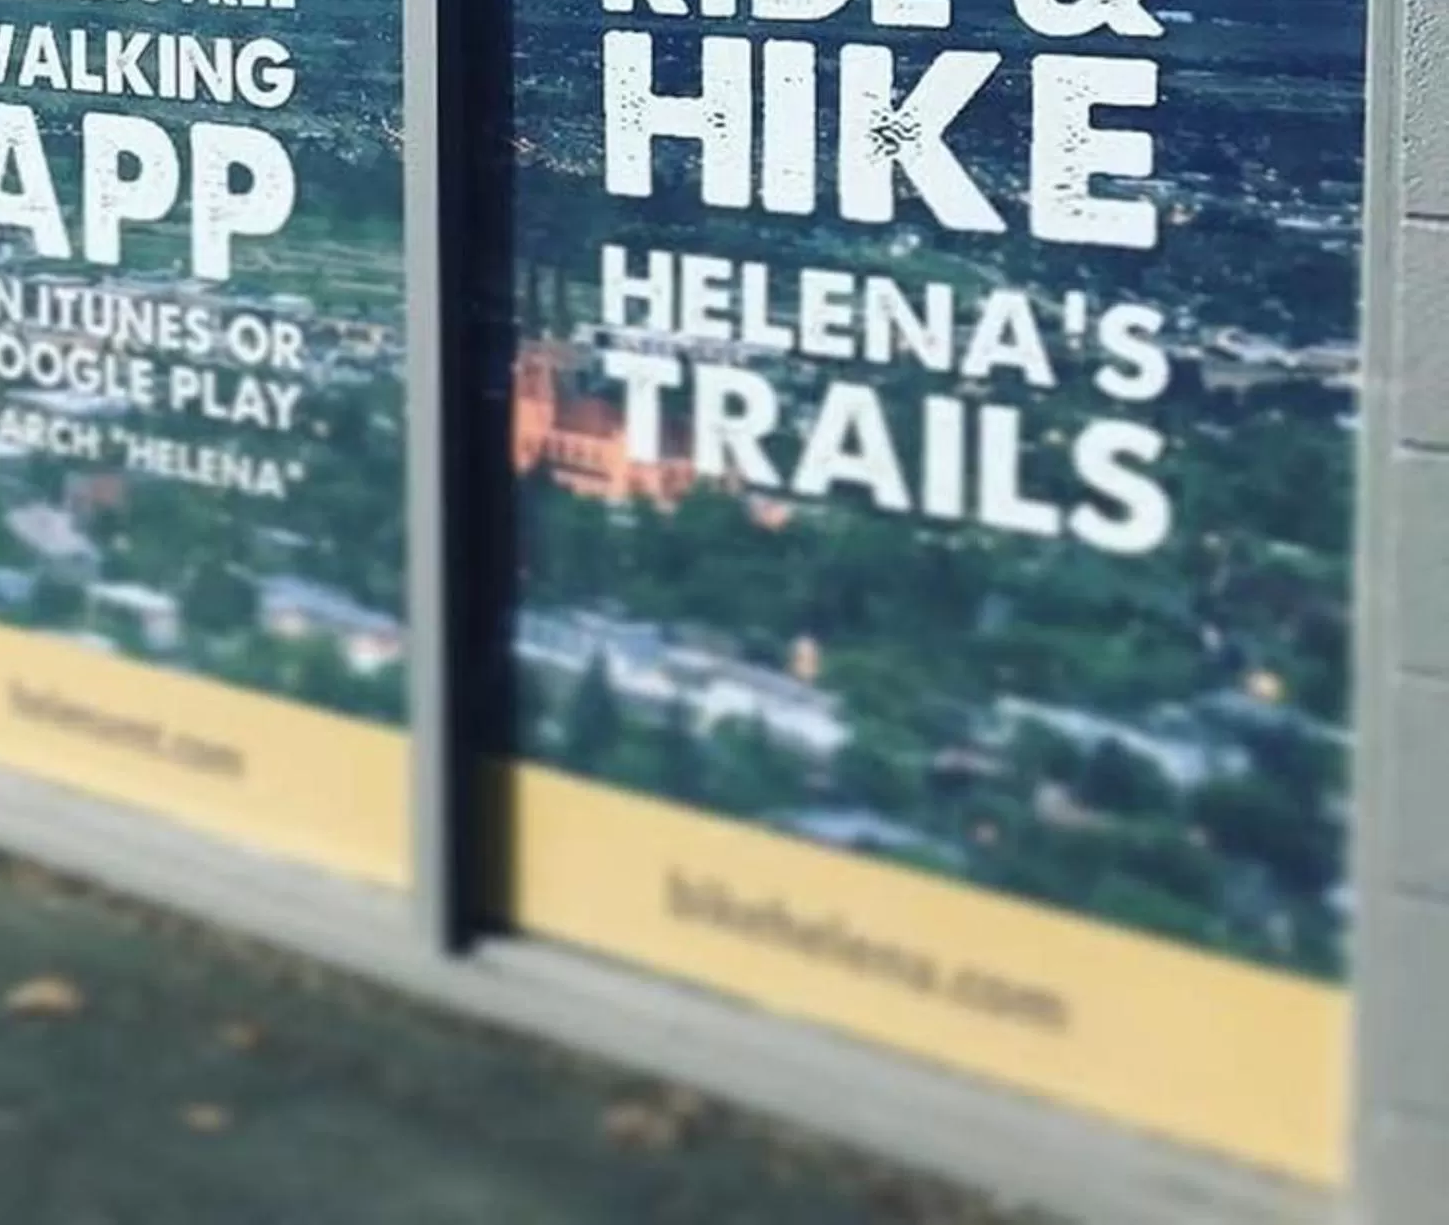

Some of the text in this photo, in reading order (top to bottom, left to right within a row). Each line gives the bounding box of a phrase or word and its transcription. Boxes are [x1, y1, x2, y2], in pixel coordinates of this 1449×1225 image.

[603, 29, 1158, 249] HIKE
[38, 285, 212, 355] ITUNES
[229, 315, 304, 371] OR
[169, 367, 302, 431] PLAY
[601, 243, 1170, 402] HELENA'S
[603, 352, 1172, 554] TRAILS
